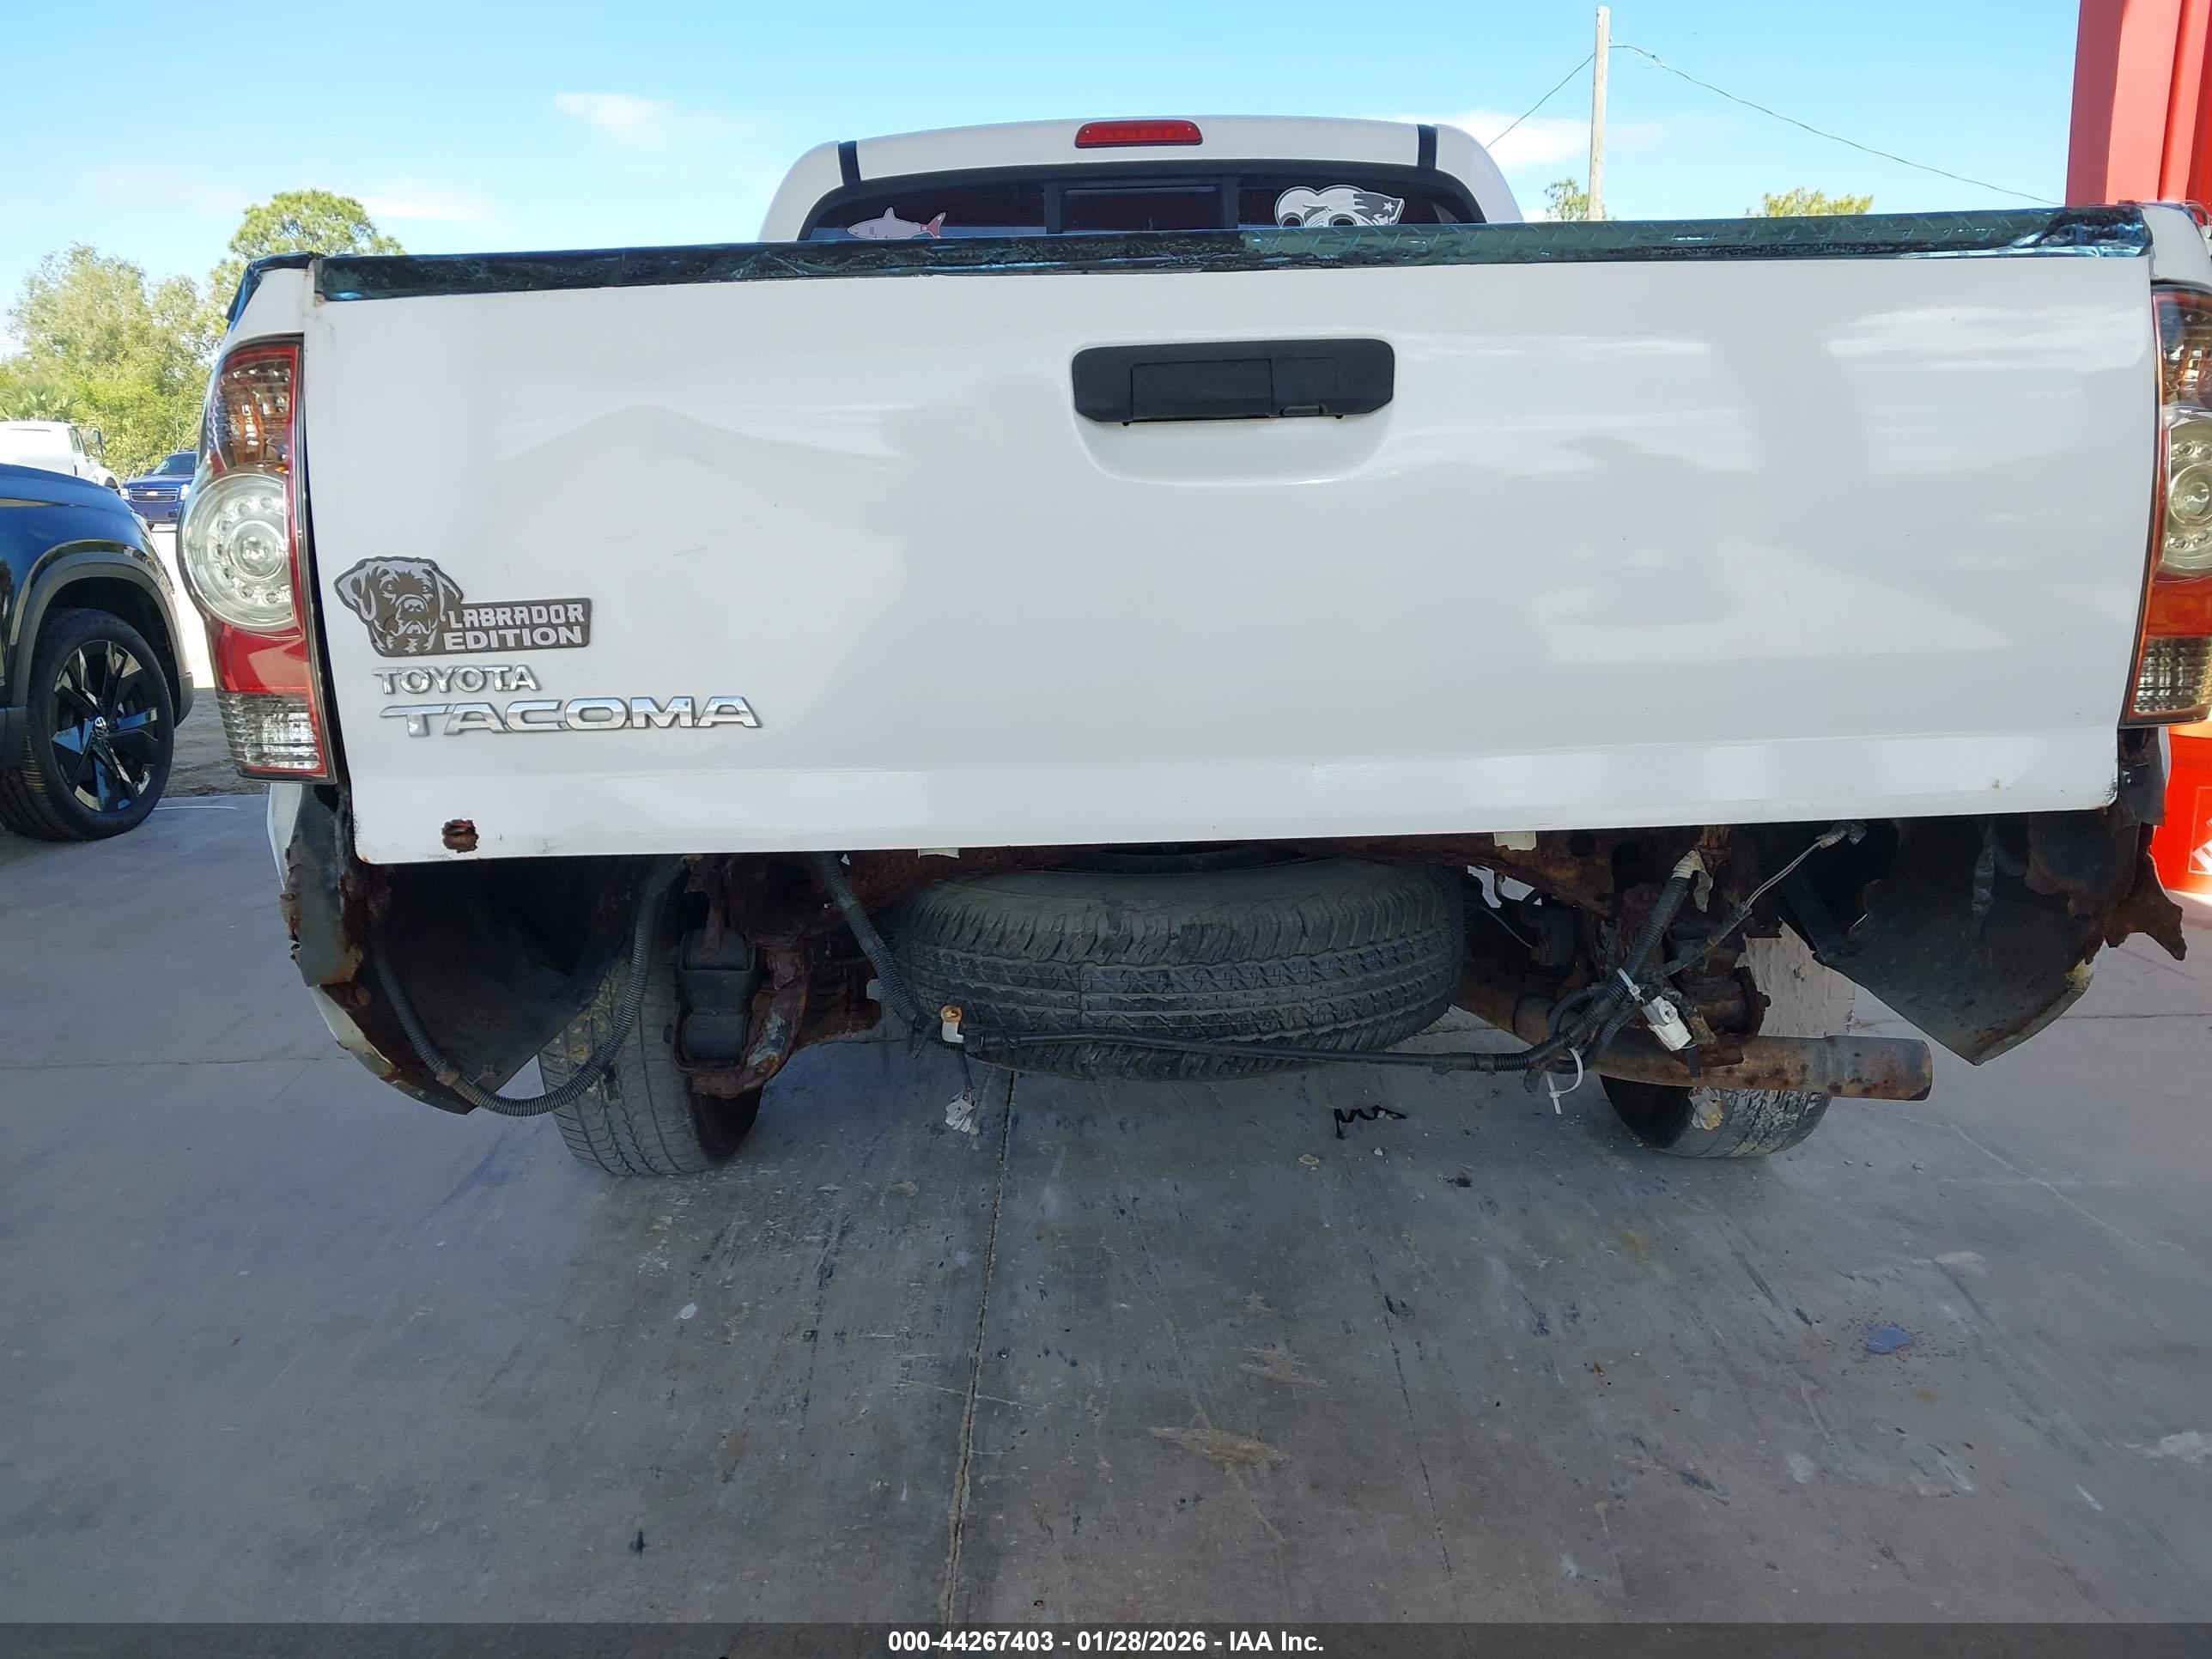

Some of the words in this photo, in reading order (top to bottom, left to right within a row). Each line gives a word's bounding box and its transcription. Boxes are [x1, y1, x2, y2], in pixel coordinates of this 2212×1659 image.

[448, 603, 586, 629] LABRADOR
[443, 626, 584, 651] EDITION
[373, 664, 540, 695] TOYOTA
[380, 696, 763, 738] TACOMA
